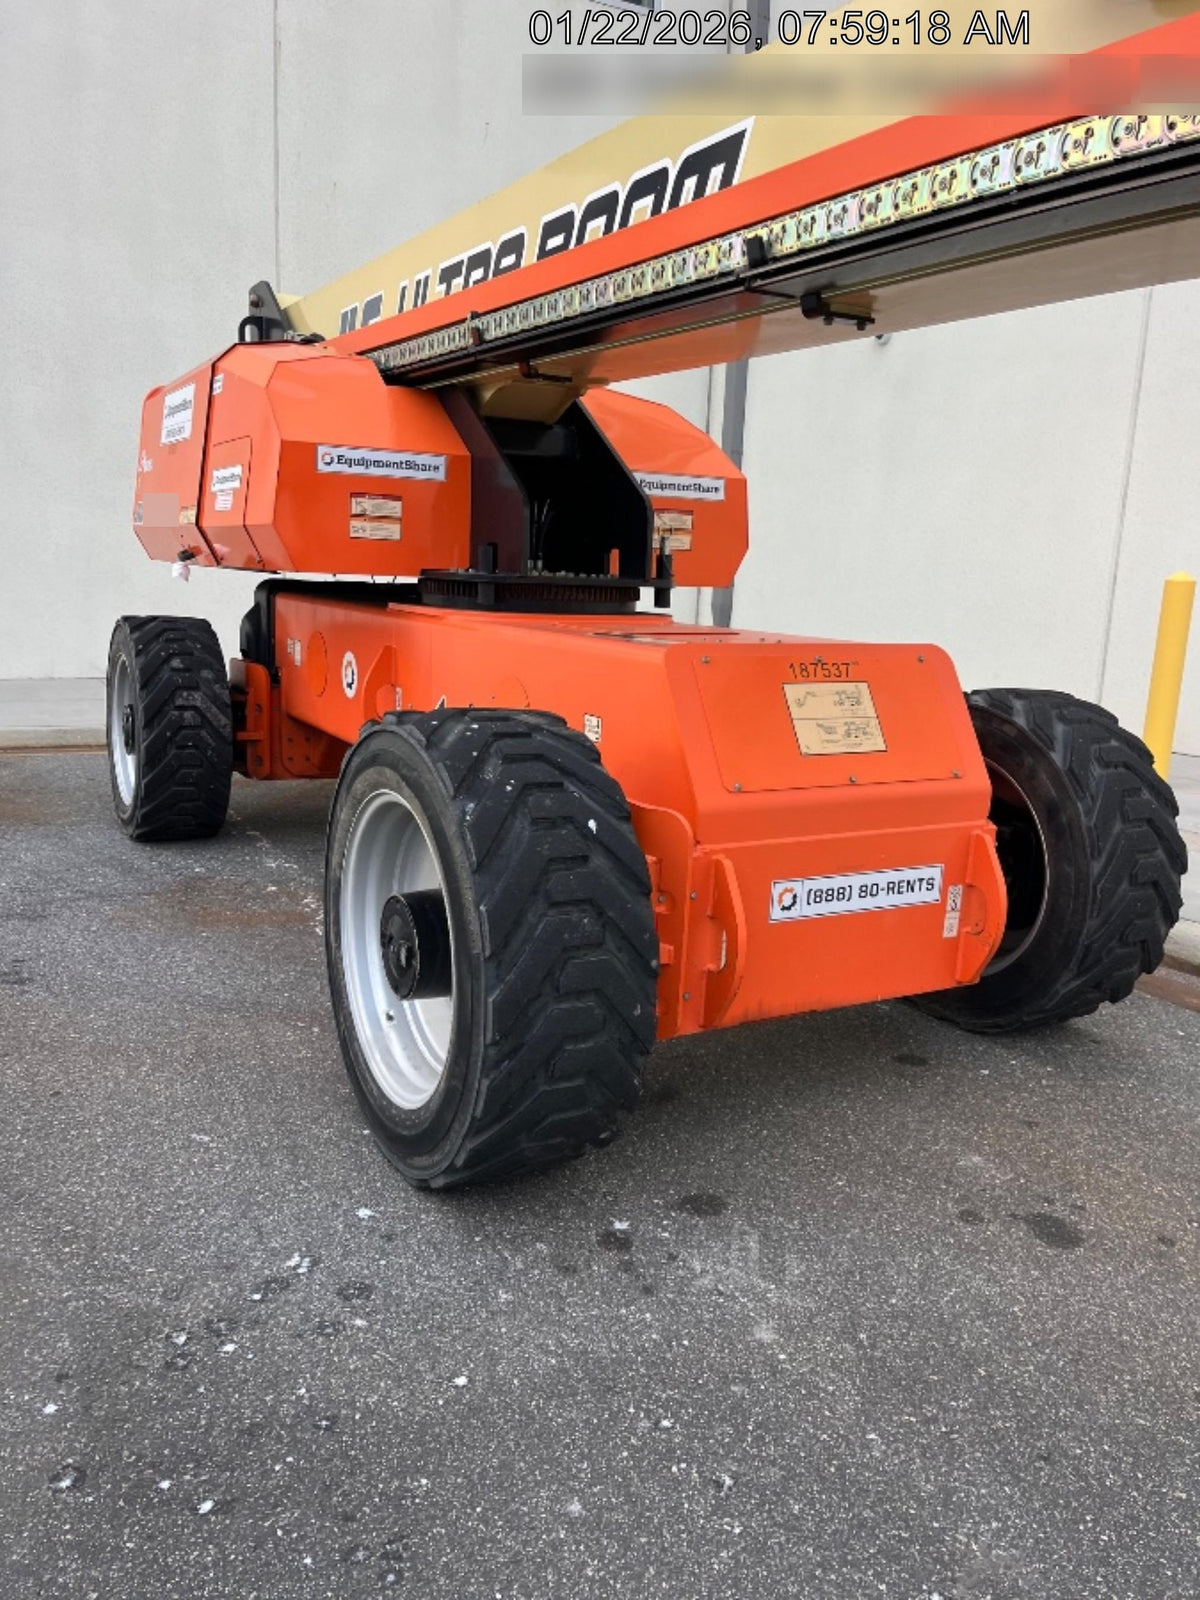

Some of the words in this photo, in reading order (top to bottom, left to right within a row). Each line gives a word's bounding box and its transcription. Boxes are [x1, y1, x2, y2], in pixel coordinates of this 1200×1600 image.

[336, 455, 440, 473] EquipmentShare
[789, 662, 850, 679] 187537
[858, 877, 935, 899] 80-RENTS
